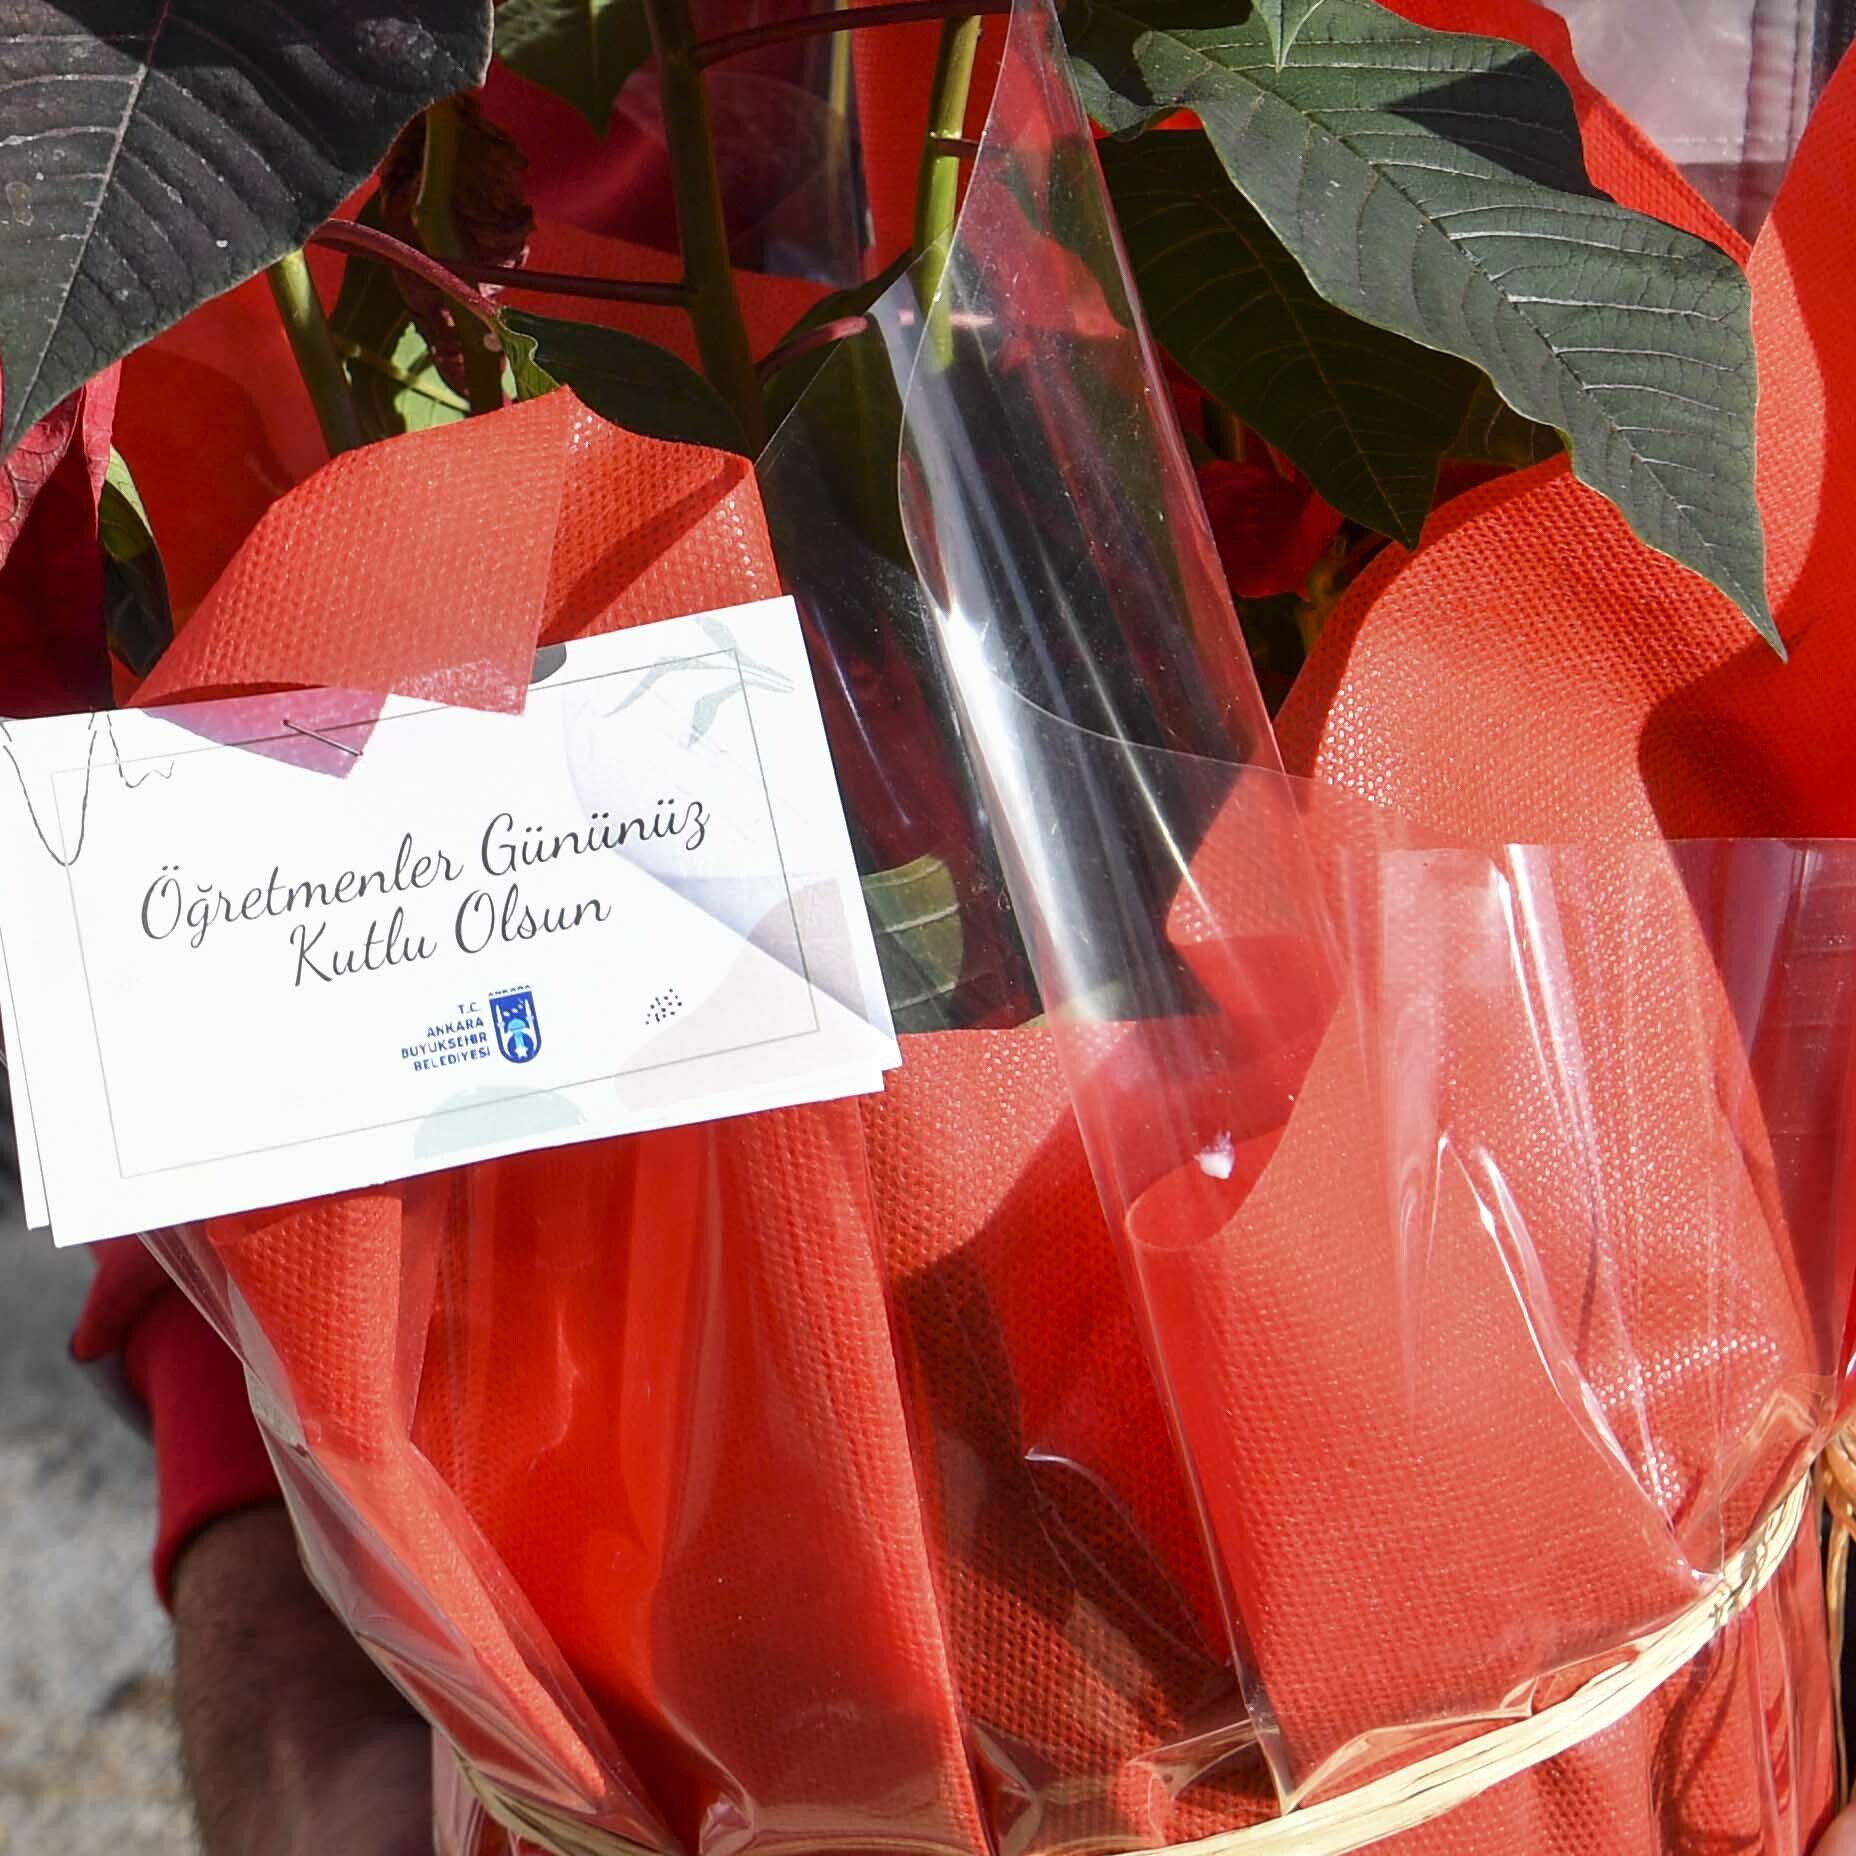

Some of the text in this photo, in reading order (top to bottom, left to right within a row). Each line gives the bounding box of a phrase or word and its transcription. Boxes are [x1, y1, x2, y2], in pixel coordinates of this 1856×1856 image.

[141, 798, 711, 948] Öğretmenler Gününüz
[290, 883, 612, 987] Kutlu Olsun
[426, 1016, 485, 1038] ANKARA
